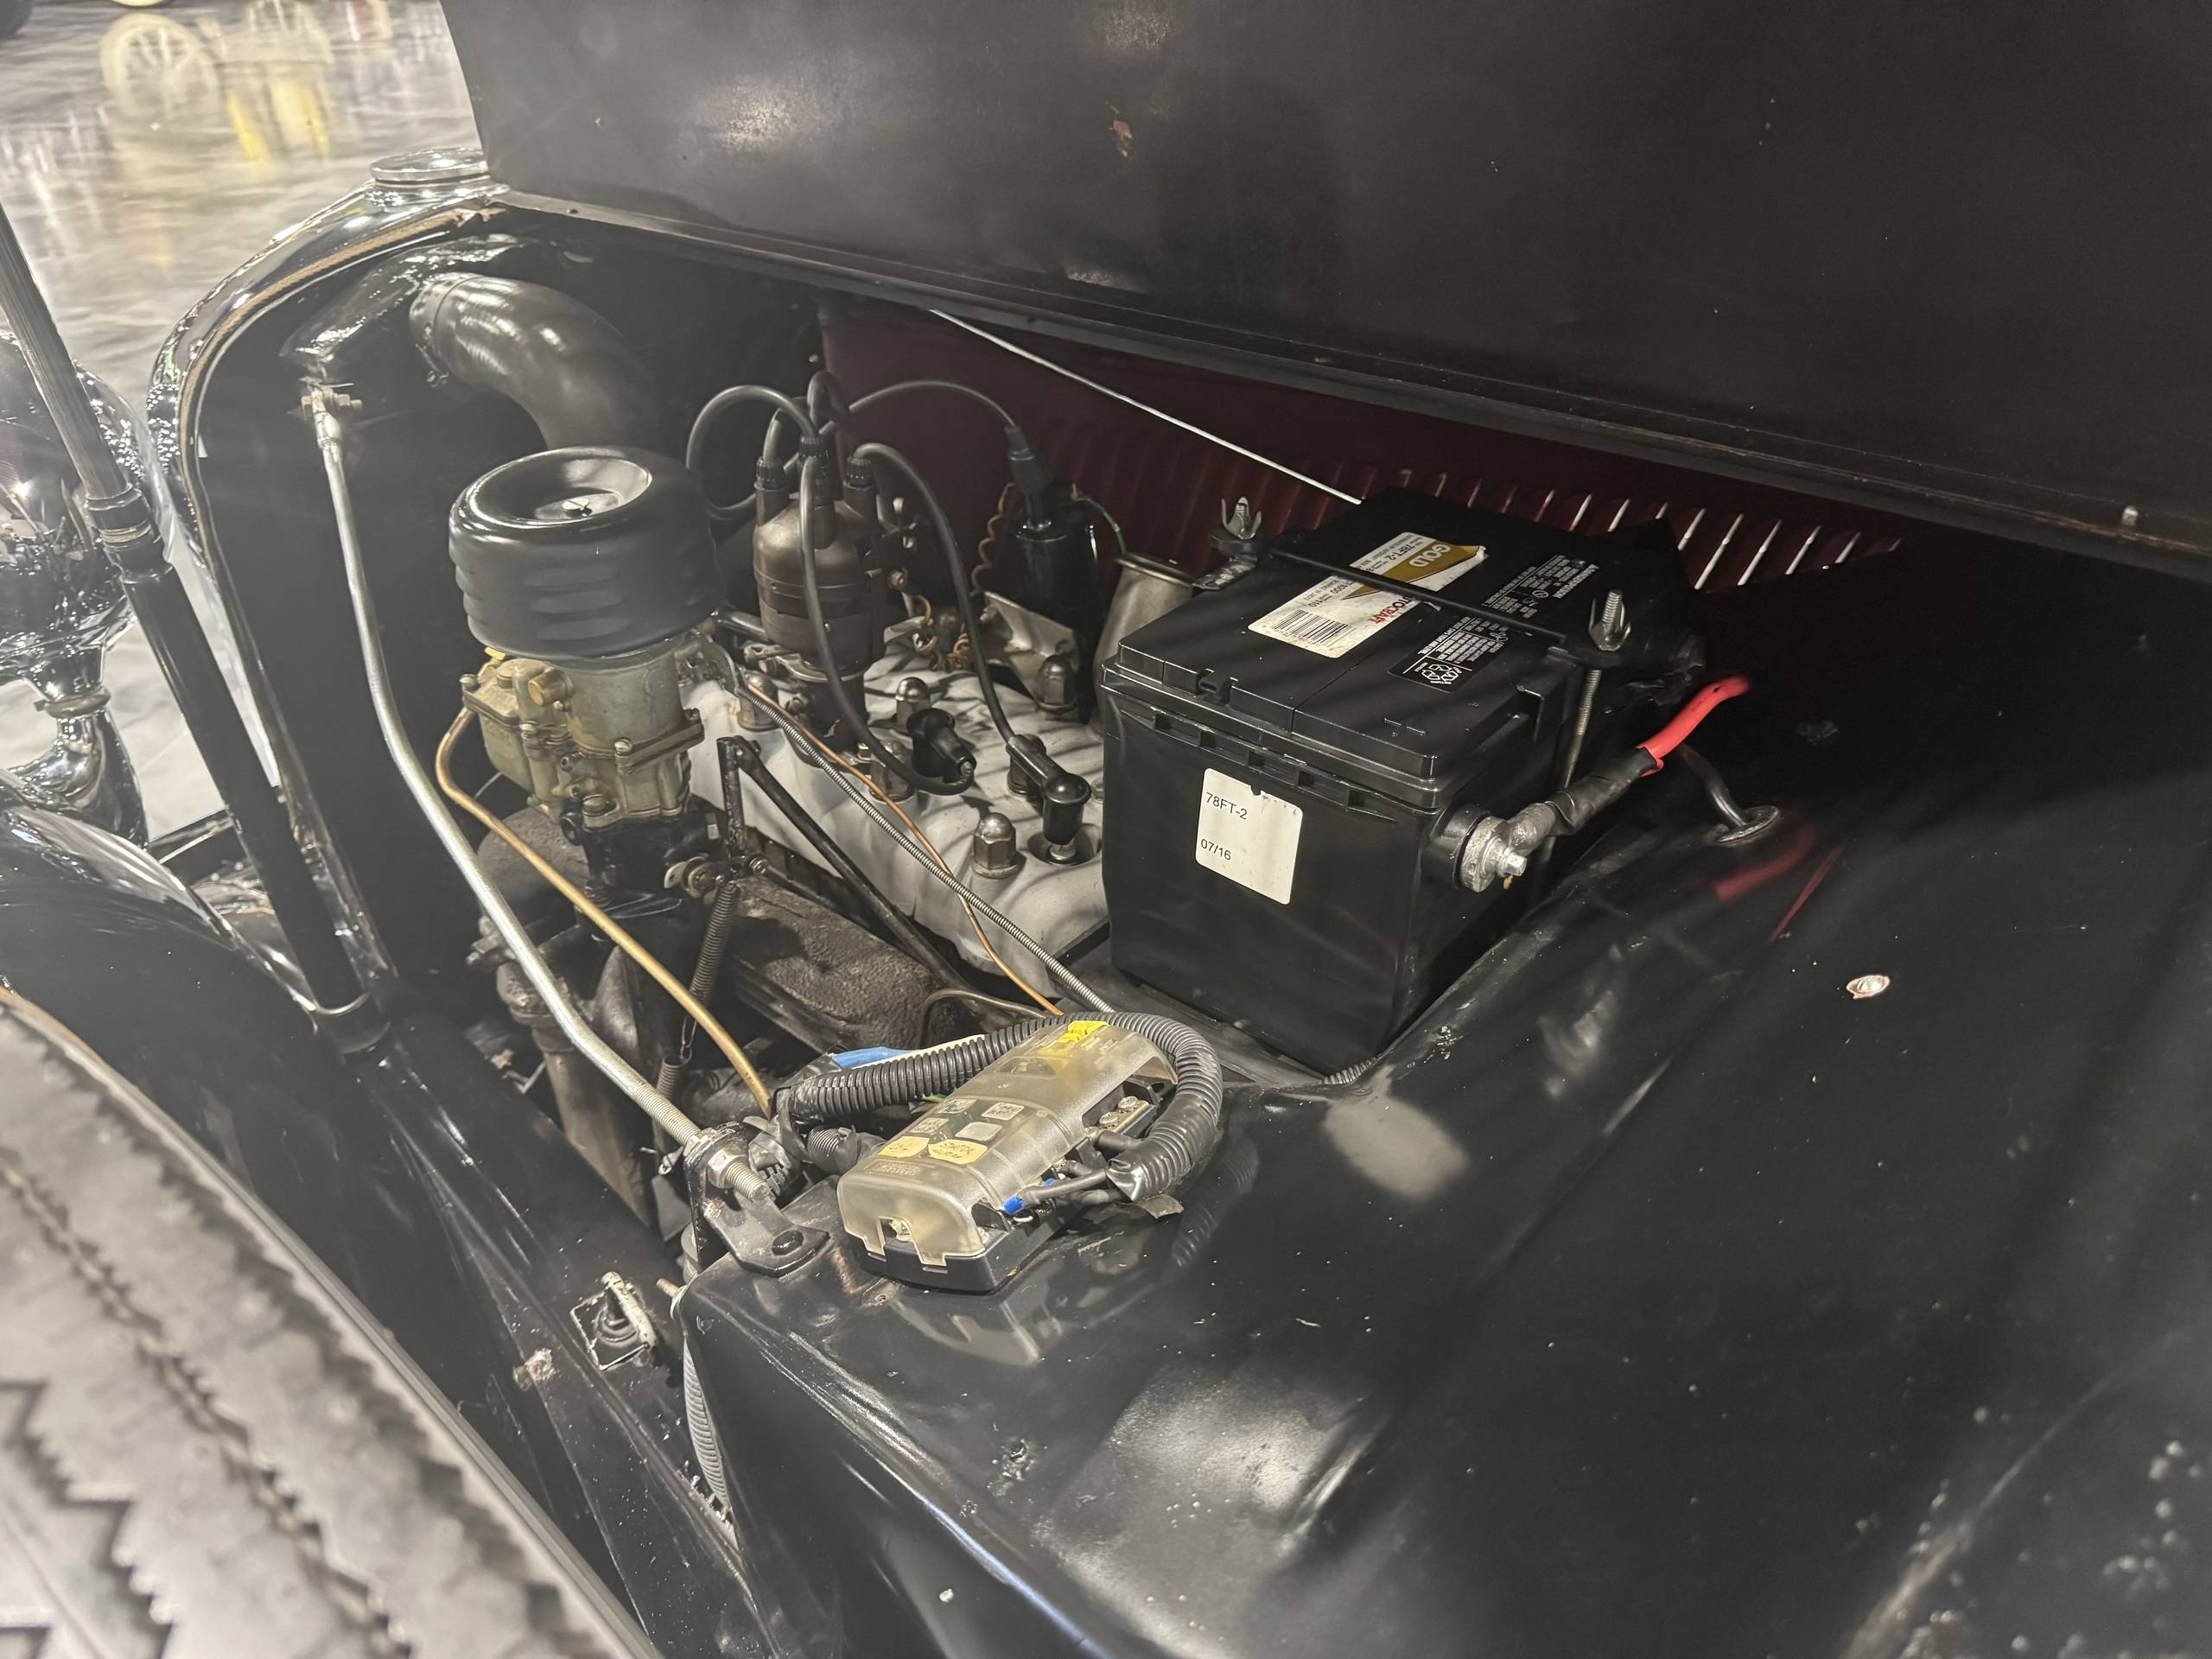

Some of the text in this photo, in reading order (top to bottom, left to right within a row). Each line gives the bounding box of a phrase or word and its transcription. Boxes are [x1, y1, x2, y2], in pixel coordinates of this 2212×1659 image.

[1385, 543, 1415, 561] 78FT-2
[1409, 544, 1452, 567] GOLD
[1369, 596, 1414, 624] UTOCRAFT
[1205, 791, 1248, 820] 78FT-2
[1200, 838, 1231, 861] 07/16
